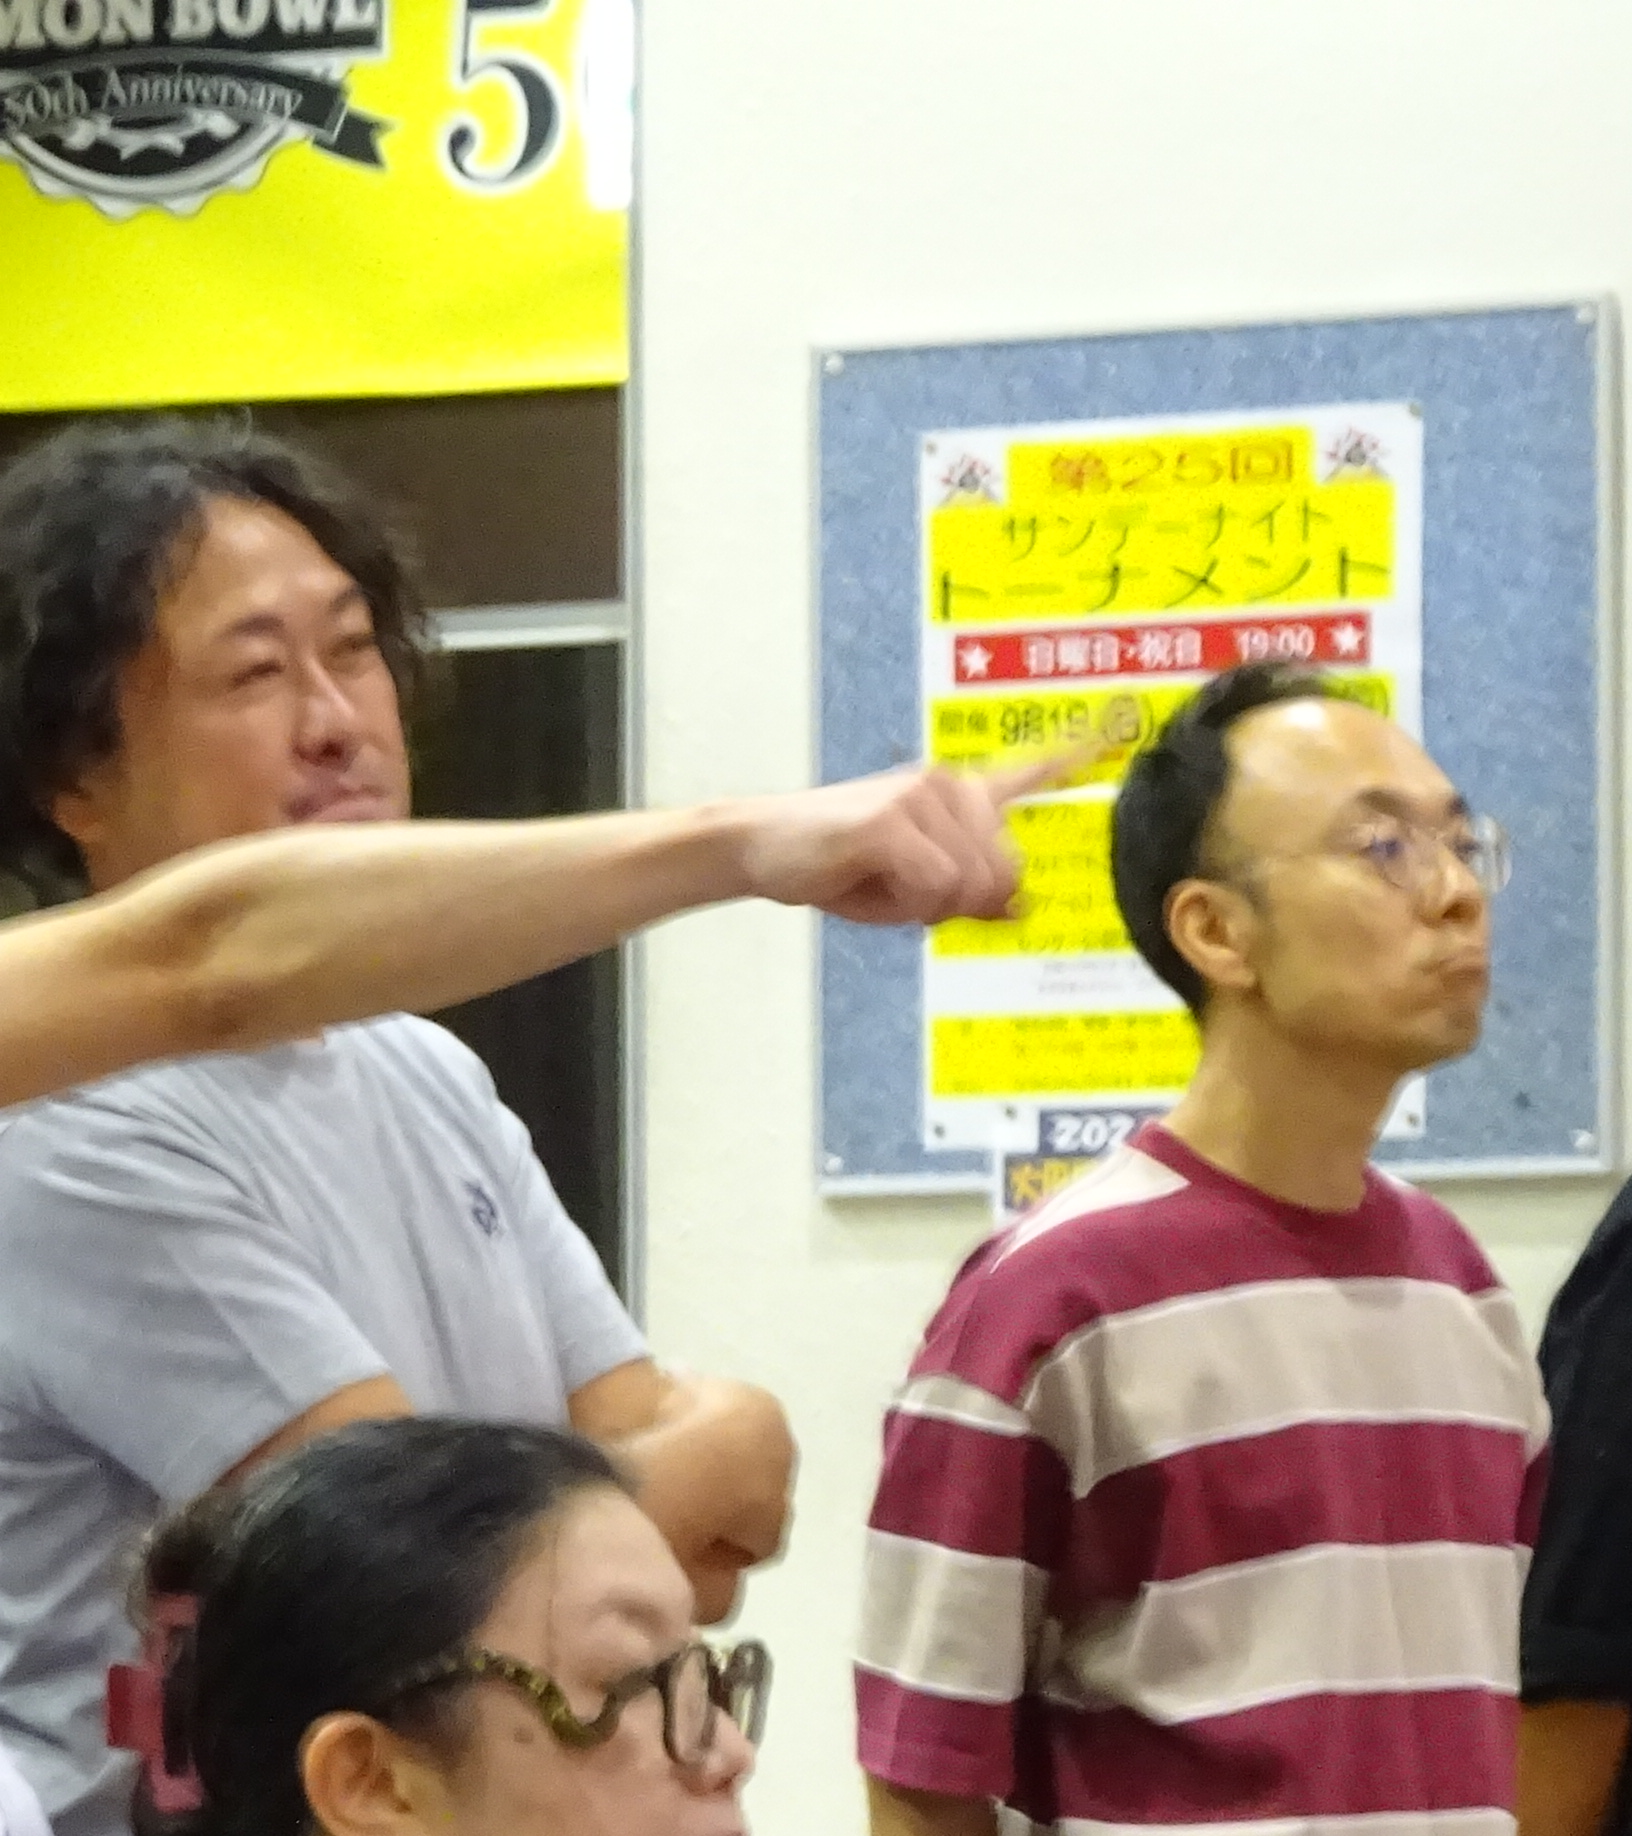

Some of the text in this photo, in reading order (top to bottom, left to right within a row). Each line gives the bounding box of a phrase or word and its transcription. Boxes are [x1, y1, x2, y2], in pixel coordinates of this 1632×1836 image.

[102, 64, 304, 121] Anniversary
[1000, 500, 1332, 561] サンデーナイト
[941, 546, 1390, 622] トーナメント
